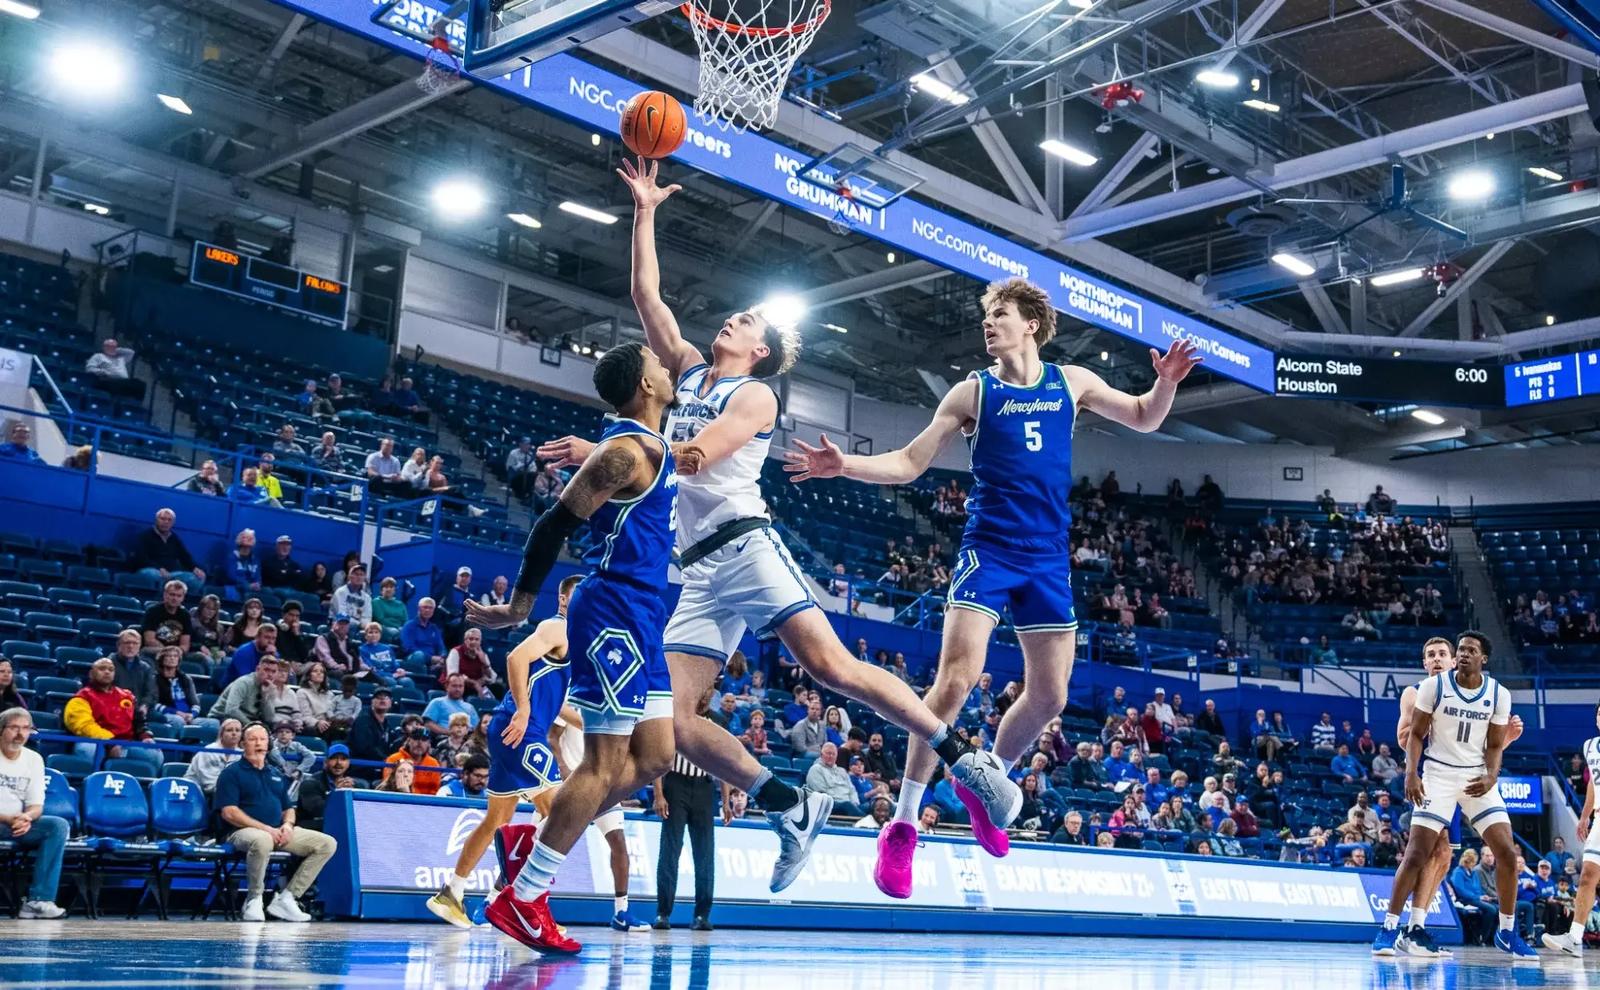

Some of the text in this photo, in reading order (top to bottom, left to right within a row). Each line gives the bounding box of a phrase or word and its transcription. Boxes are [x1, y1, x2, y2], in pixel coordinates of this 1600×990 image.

[785, 176, 873, 226] GRUMMAN
[205, 248, 239, 265] LAKERS
[911, 217, 1030, 279] NGC.com/Careers
[305, 275, 340, 293] FALCONS
[1059, 271, 1125, 309] NORTHROP
[1068, 291, 1134, 330] GRUMMAN
[1161, 320, 1251, 369] NGCcom/Careers
[1276, 357, 1488, 383] Alcorn State 6:00
[1277, 376, 1338, 393] Houston
[1528, 376, 1543, 388] PTS
[996, 398, 1063, 416] Mercyhurst
[1023, 420, 1043, 452] 5
[1443, 706, 1490, 721] AIR FORCE
[1456, 721, 1471, 744] 11
[104, 774, 125, 796] AF
[169, 780, 190, 801] AF
[1501, 782, 1531, 800] SHOP
